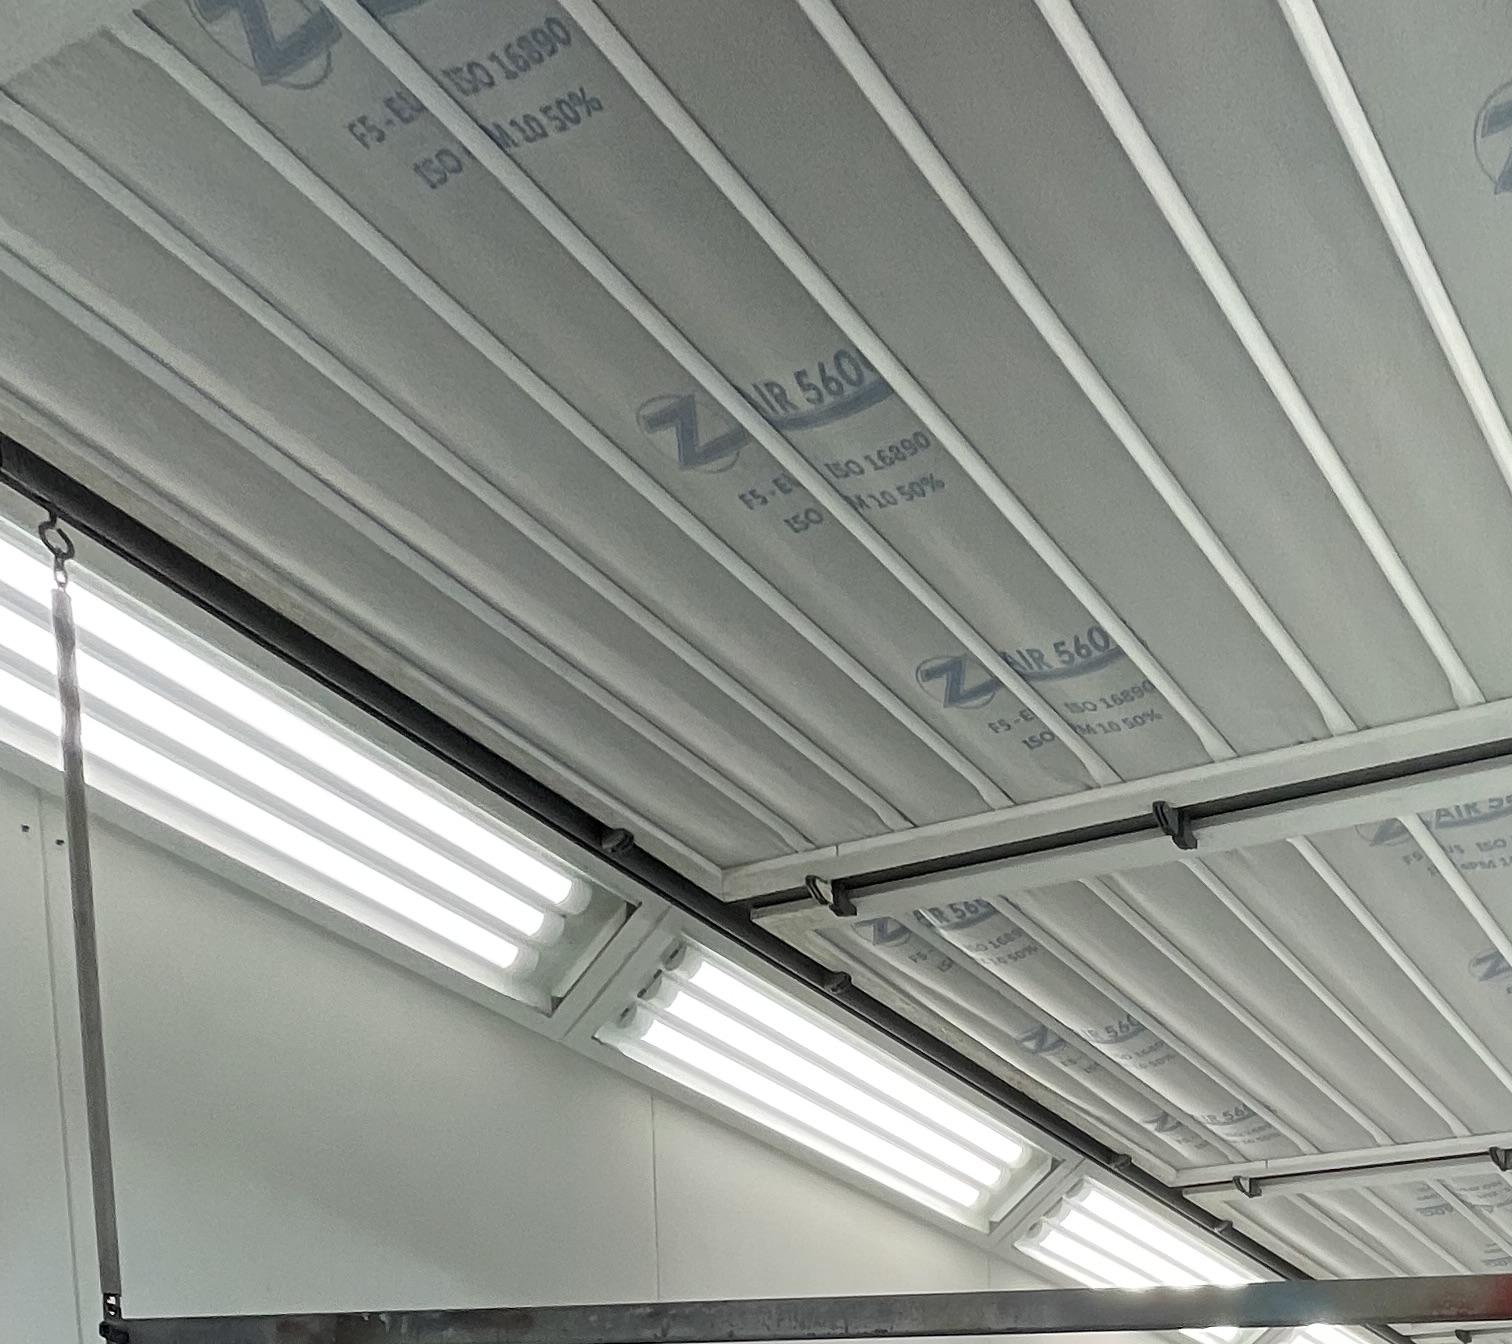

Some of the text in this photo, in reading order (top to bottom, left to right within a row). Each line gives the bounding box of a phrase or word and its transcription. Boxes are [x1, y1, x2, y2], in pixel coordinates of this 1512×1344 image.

[347, 115, 386, 150] F5
[441, 61, 496, 97] ISO
[488, 17, 572, 81] 16890
[413, 148, 464, 190] ISO
[509, 113, 549, 143] 10
[539, 86, 604, 132] 50%
[824, 459, 865, 480] ISO
[864, 431, 931, 471] 16890
[784, 507, 824, 533] ISO
[896, 473, 945, 501] 50%
[1064, 701, 1098, 714] ISO
[1022, 730, 1056, 750] ISO
